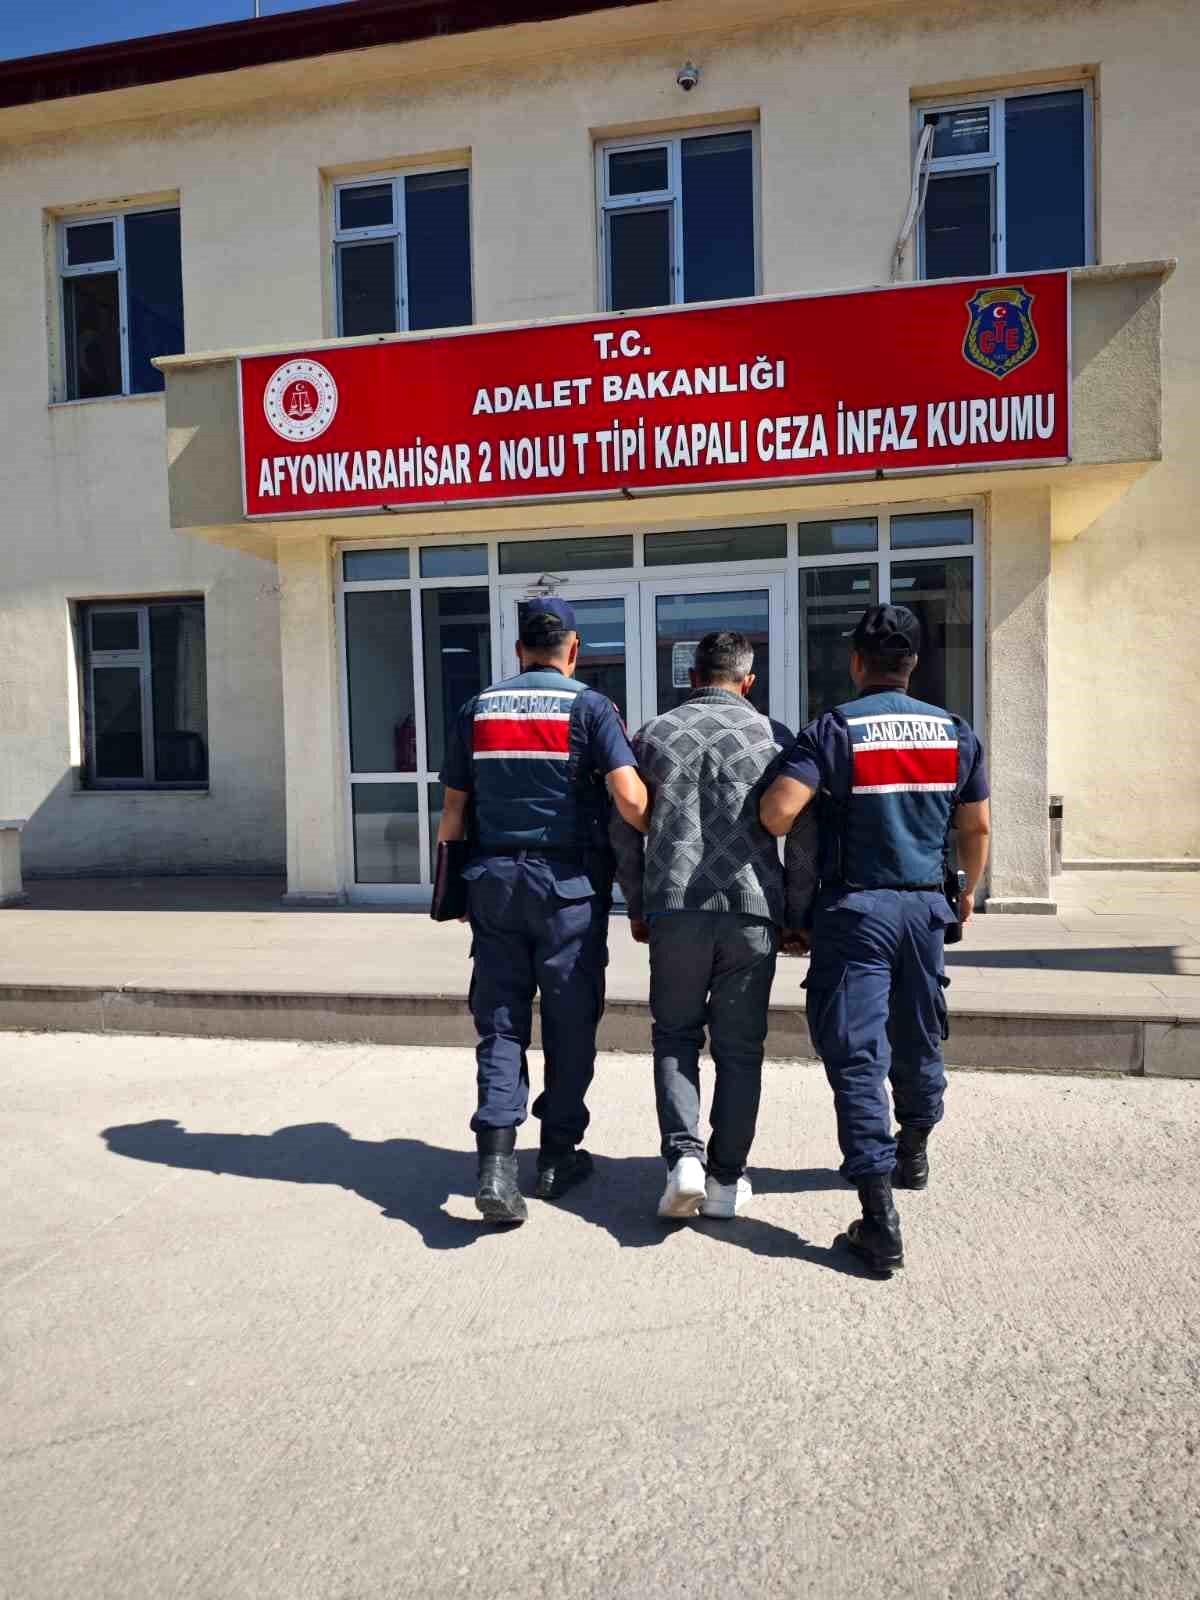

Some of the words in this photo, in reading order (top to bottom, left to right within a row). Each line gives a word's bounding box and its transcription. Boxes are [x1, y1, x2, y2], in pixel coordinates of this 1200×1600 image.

[593, 329, 651, 360] T.C.
[472, 377, 593, 416] ADALET
[602, 355, 786, 403] BAKANLIĞI
[258, 436, 472, 498] AFYONKARAHİSAR
[477, 441, 493, 483] 2
[499, 434, 566, 481] NOLU
[572, 432, 589, 475] T
[595, 416, 646, 473] TİPİ
[654, 418, 748, 469] KAPALI
[756, 413, 829, 462] CEZA
[837, 400, 918, 456] İNFAZ
[926, 392, 1056, 448] KURUMU
[482, 695, 561, 714] JANDARMA
[862, 721, 949, 742] JANDARMA
